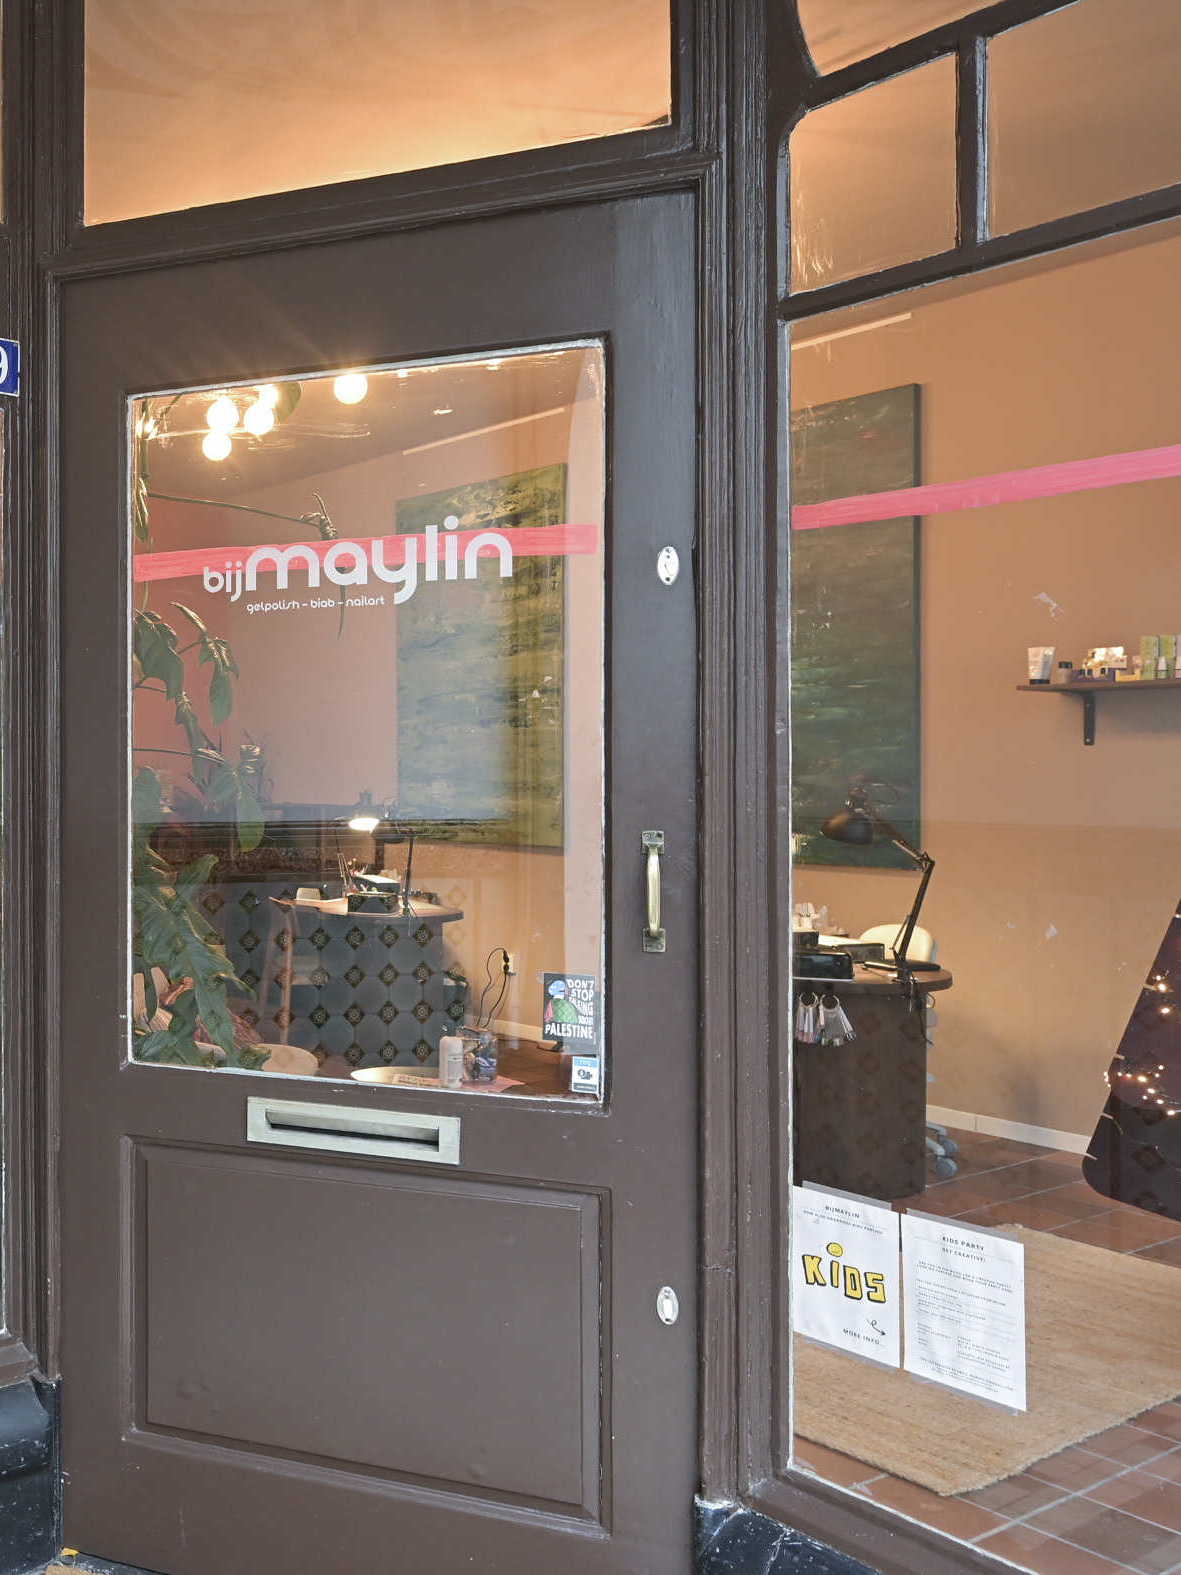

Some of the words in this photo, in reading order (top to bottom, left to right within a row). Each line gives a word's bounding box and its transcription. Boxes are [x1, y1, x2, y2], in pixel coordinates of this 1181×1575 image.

[247, 597, 300, 615] gelpolish
[310, 598, 335, 609] biab
[346, 594, 385, 608] nailart
[566, 979, 595, 990] DON'T
[571, 988, 595, 1002] STOP
[569, 996, 593, 1016] TALKING
[578, 1016, 593, 1026] ABOUT
[545, 1022, 593, 1040] PALESTINE
[825, 1205, 860, 1219] BIJMAYLIN
[943, 1236, 958, 1245] KIDS
[961, 1240, 984, 1252] PARTY
[954, 1250, 986, 1263] CREATIVE!
[801, 1242, 886, 1304] KIDS
[843, 1328, 860, 1339] MORE
